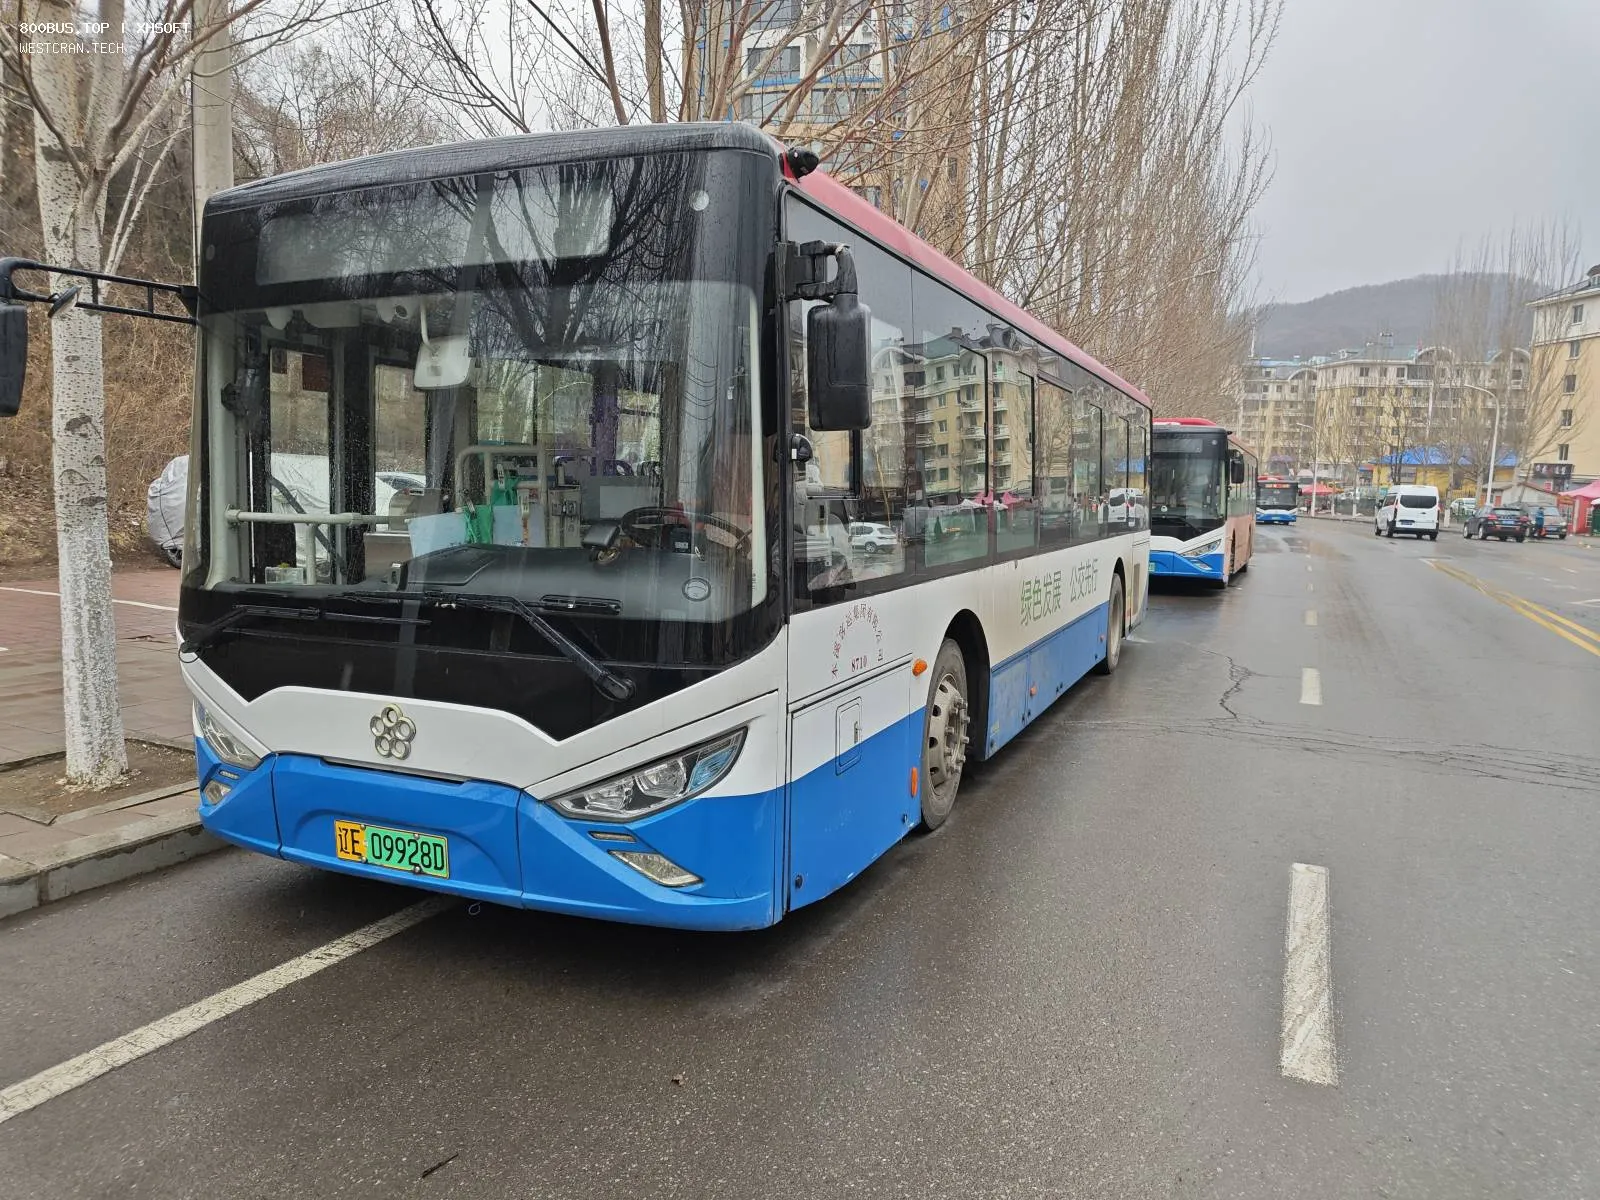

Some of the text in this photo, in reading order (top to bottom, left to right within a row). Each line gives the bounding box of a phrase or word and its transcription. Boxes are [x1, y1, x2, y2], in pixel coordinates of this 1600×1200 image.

[1020, 558, 1098, 626] 绿色发展 公交先行
[851, 655, 868, 672] 8710
[371, 832, 445, 871] 09928D
